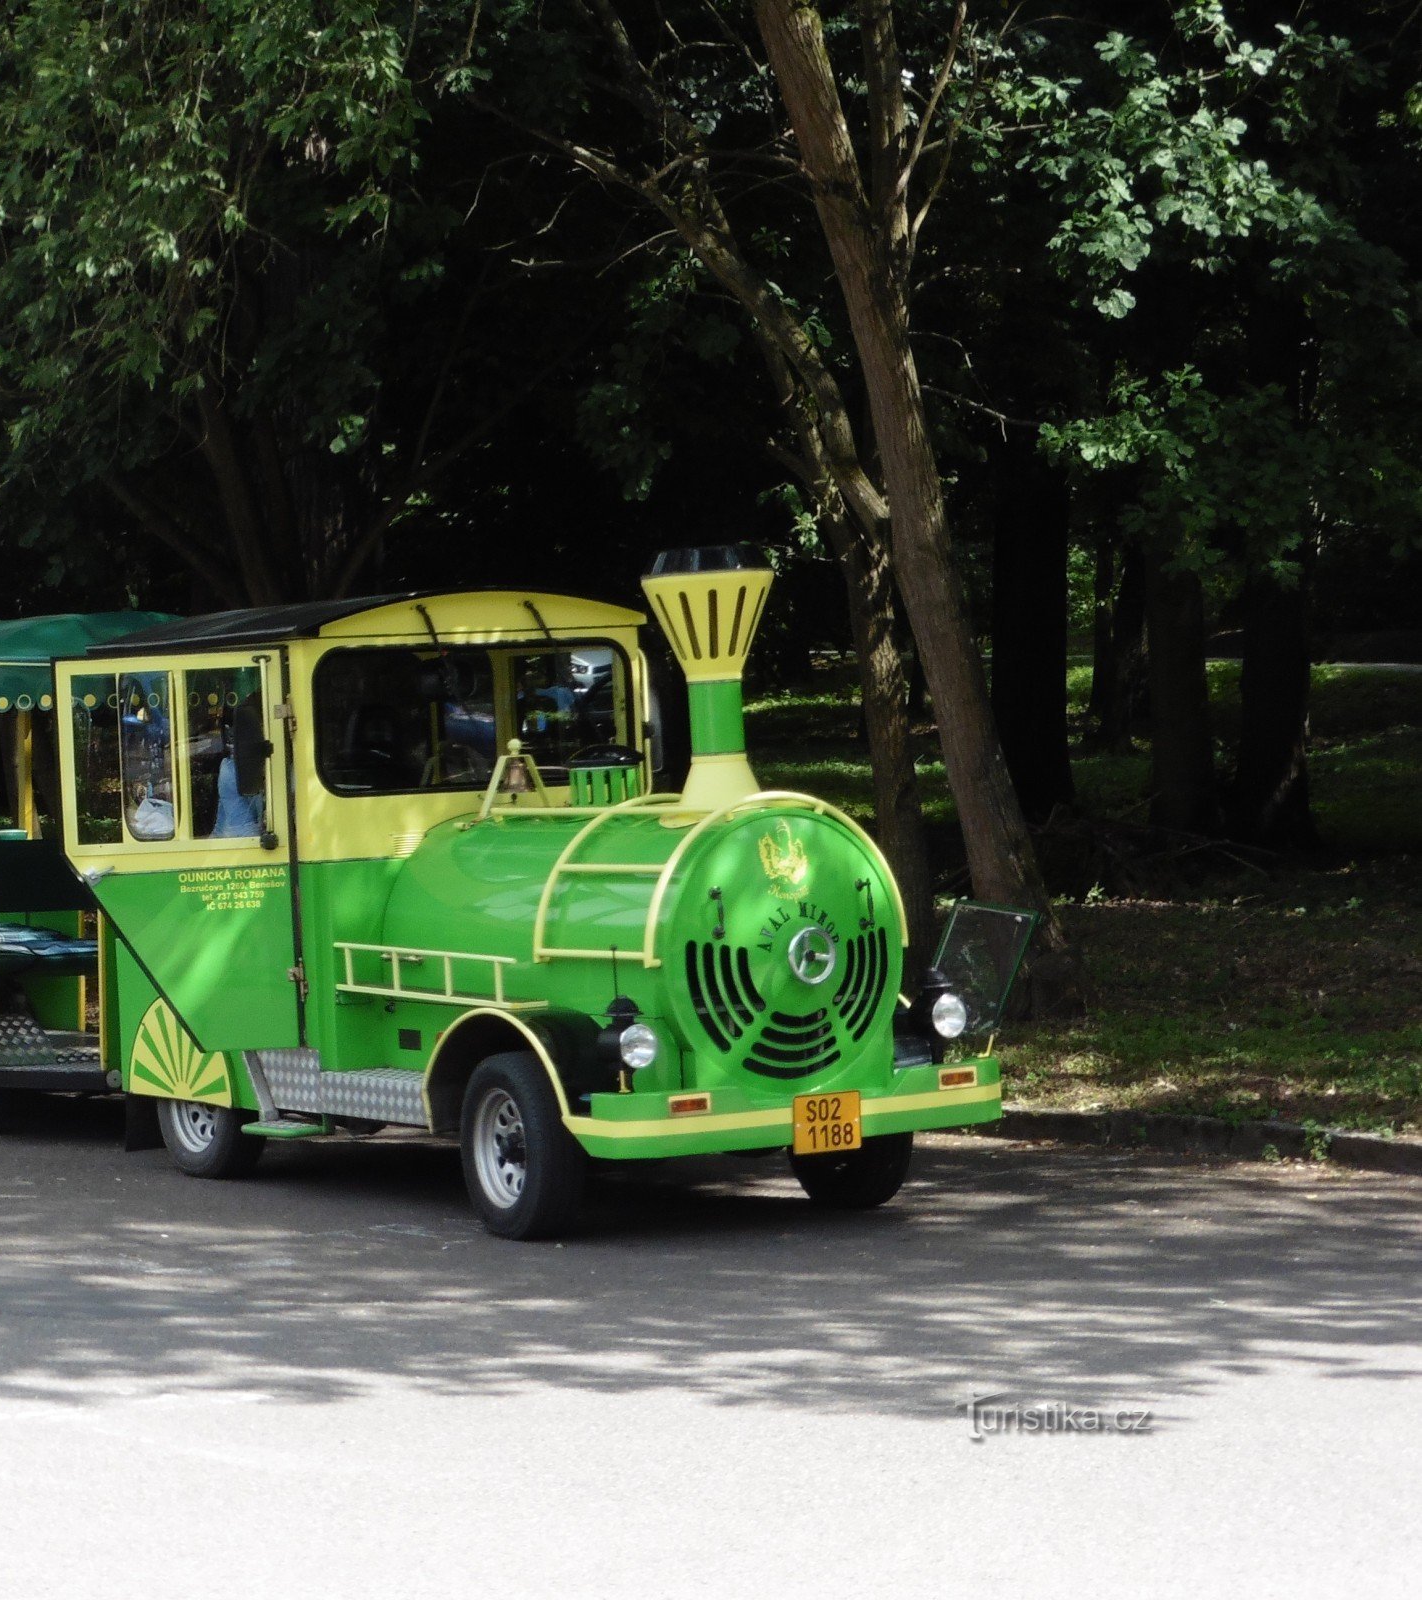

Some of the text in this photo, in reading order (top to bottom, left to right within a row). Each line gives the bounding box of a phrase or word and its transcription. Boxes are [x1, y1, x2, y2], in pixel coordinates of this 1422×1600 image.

[234, 867, 286, 879] ROMANA
[217, 892, 231, 900] 737
[807, 1122, 854, 1149] 1188
